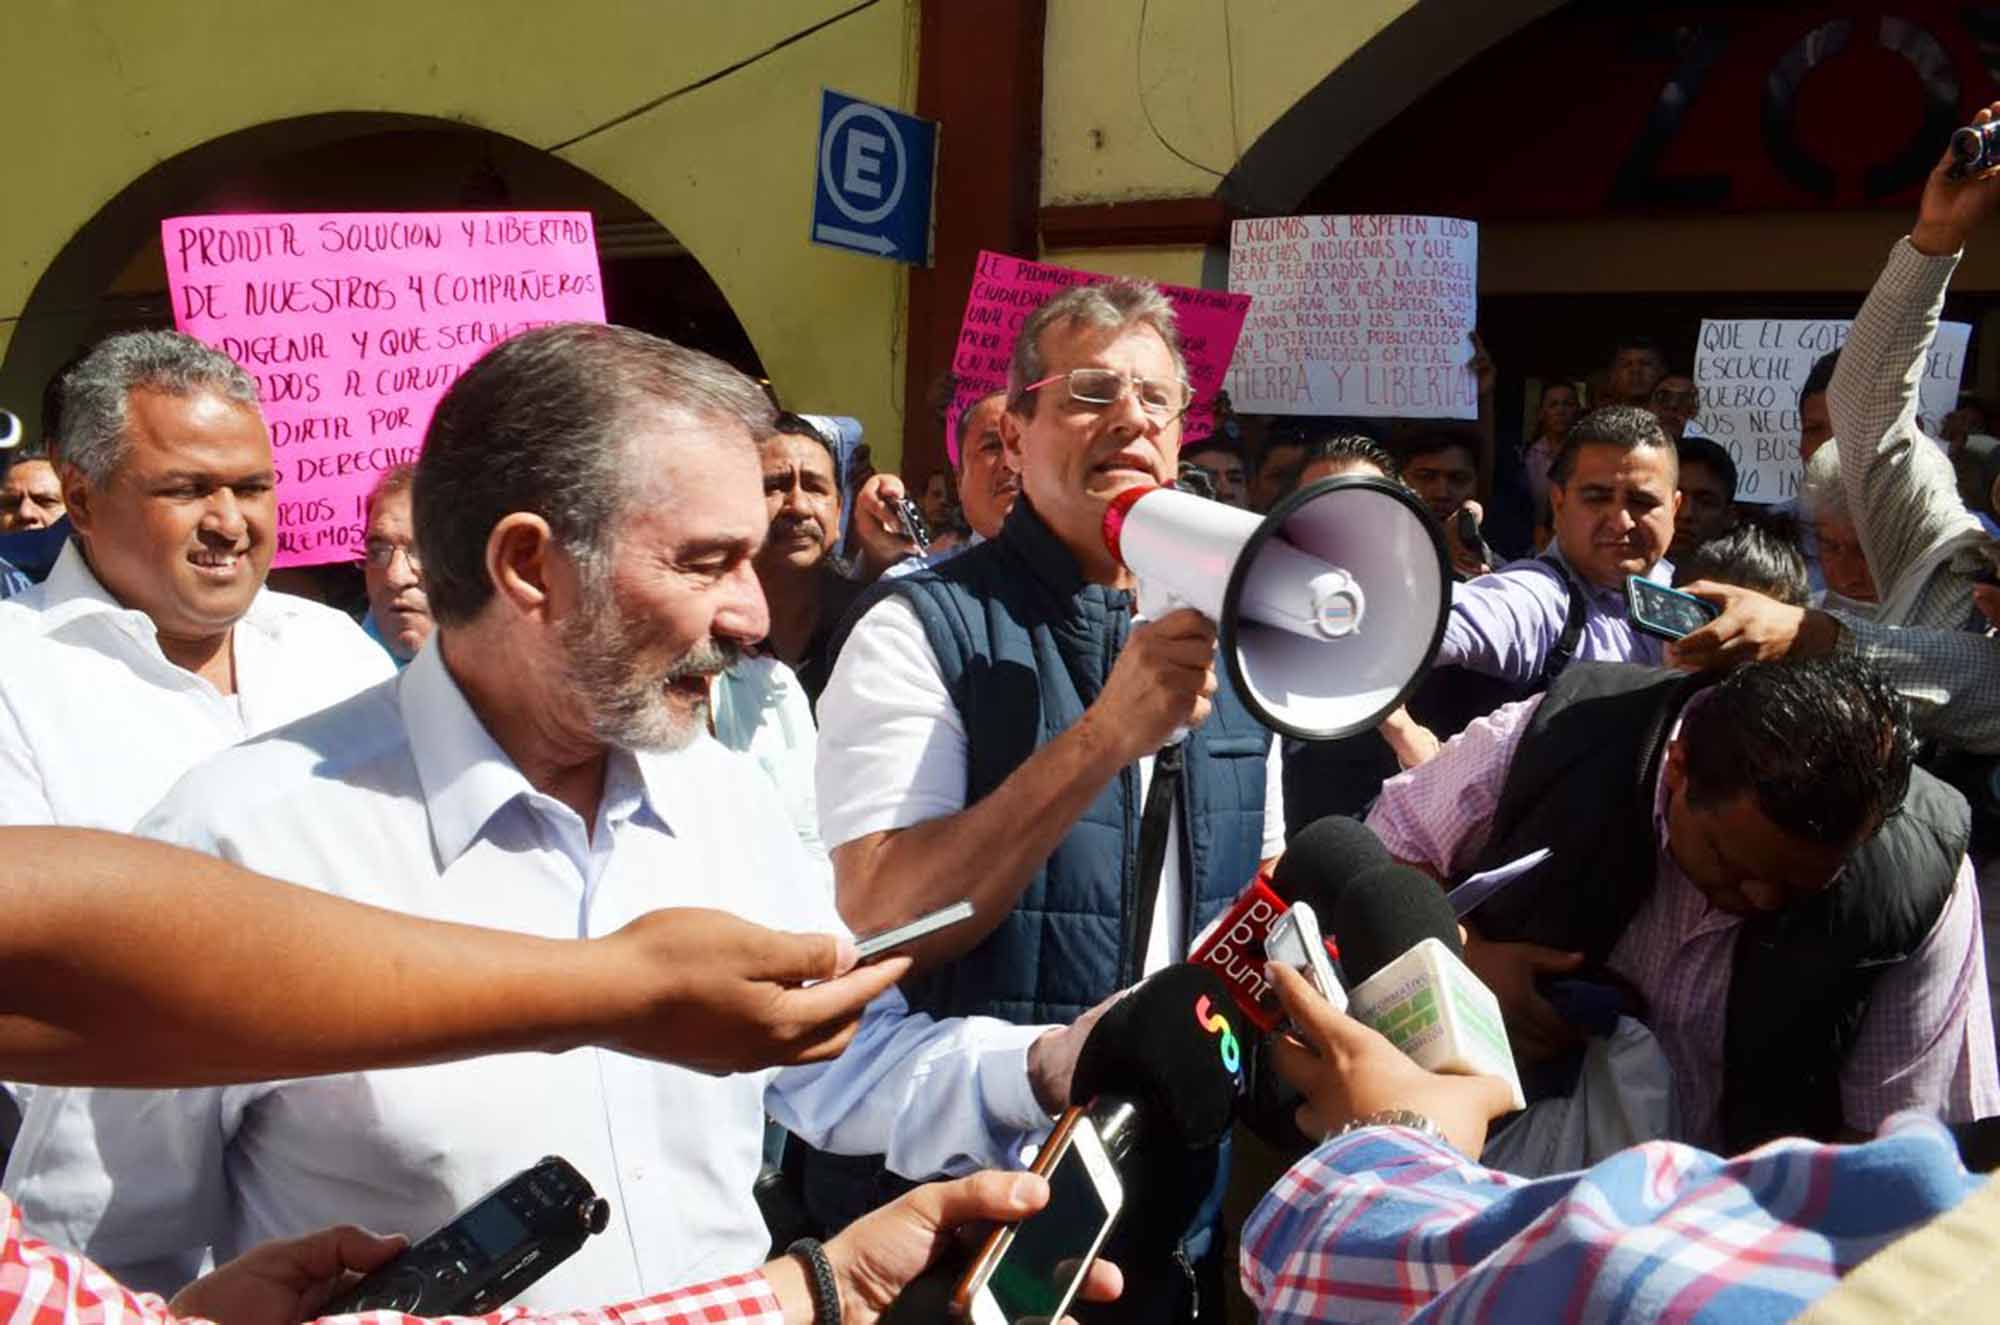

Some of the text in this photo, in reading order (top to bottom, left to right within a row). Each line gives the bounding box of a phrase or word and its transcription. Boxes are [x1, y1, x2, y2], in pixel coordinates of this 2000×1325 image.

[844, 127, 886, 199] E
[178, 215, 589, 273] PRONTA SOLUCION Y LIBERTAD
[1234, 215, 1470, 246] EXIGIMOS SE RESPETEN LOS
[1231, 239, 1456, 265] DERECHOS INDIGENAS Y QUE
[1278, 259, 1368, 281] REGRESADOS
[1376, 261, 1387, 278] A
[182, 284, 227, 320] DE
[245, 276, 397, 315] NUESTROS
[434, 269, 596, 305] COMPAÑEROS
[213, 333, 329, 365] DIGENA
[379, 325, 431, 357] QUE
[1703, 321, 1744, 351] QUE
[1759, 320, 1784, 349] EL
[1698, 353, 1793, 381] ESCUCHE
[1231, 363, 1313, 404] TIERRA
[1330, 363, 1351, 402] Y
[1697, 384, 1776, 409] PUEBLO
[368, 407, 413, 435] POR
